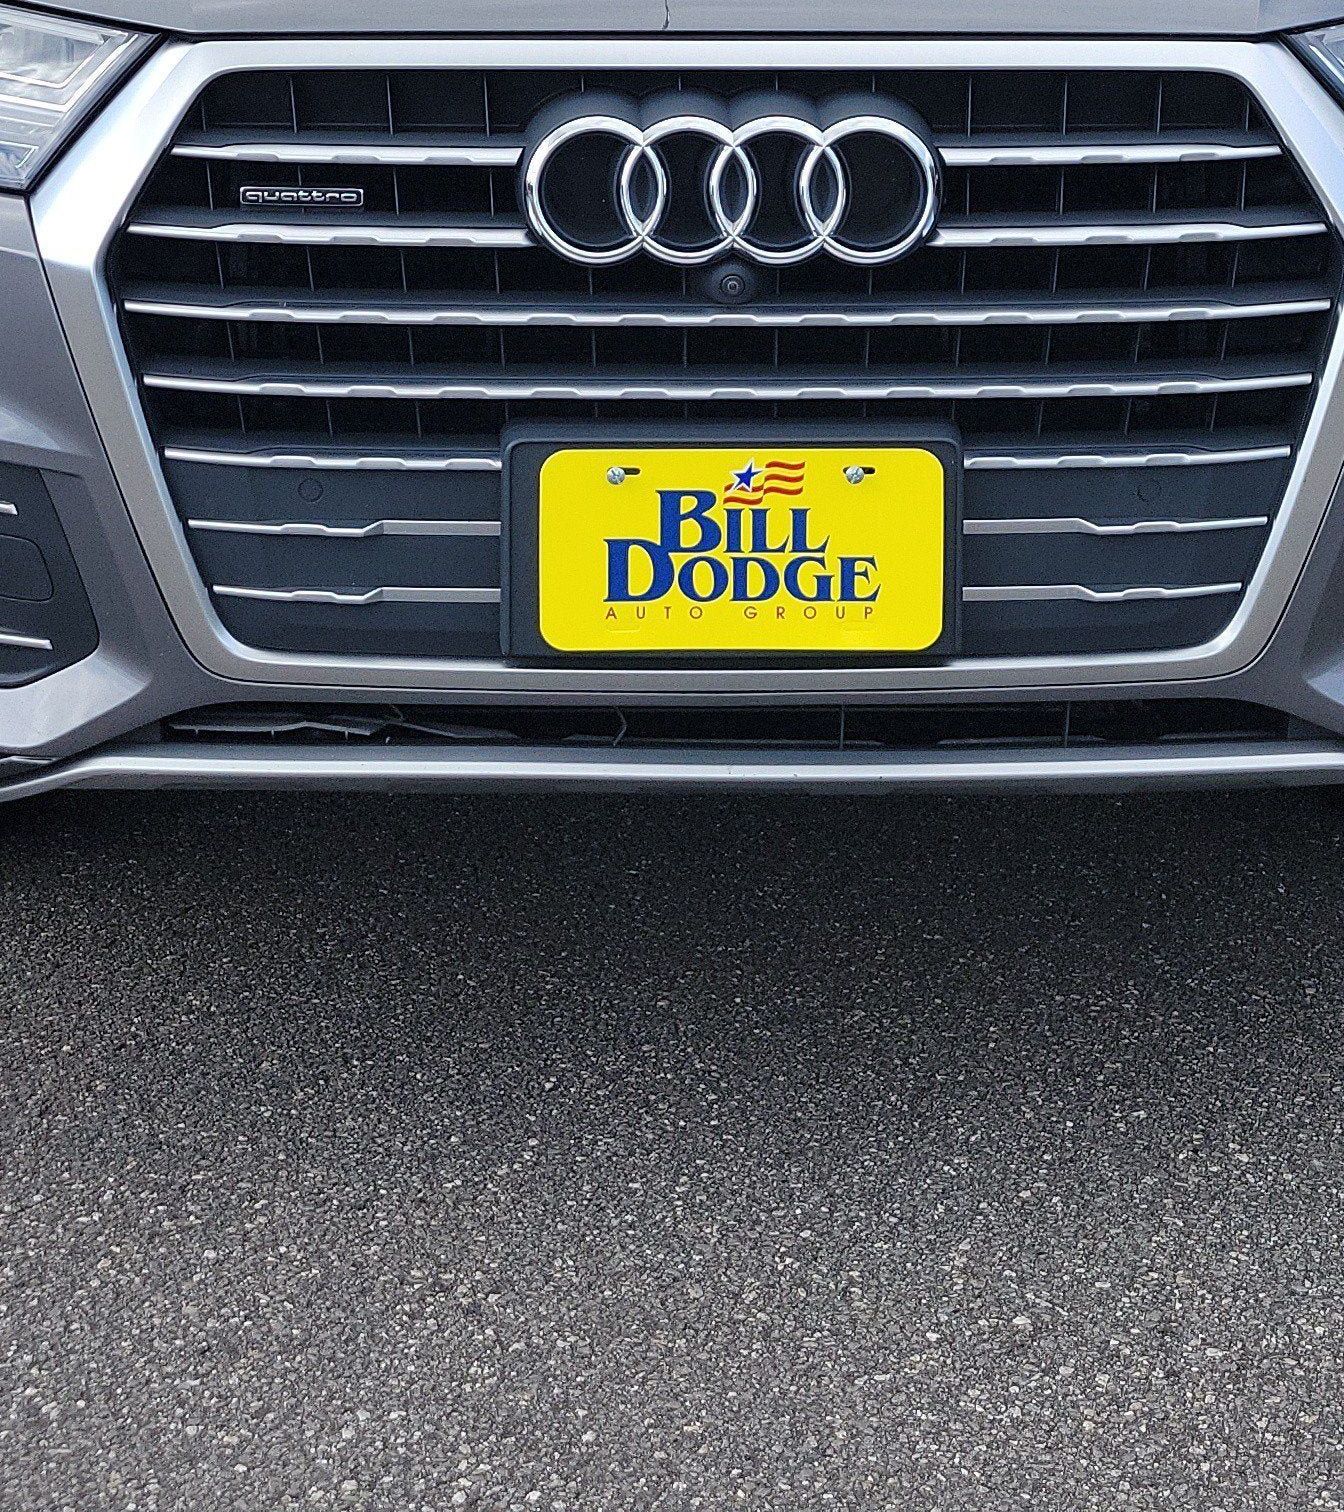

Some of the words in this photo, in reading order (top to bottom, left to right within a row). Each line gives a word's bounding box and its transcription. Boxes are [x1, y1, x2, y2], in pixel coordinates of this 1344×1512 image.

[245, 190, 358, 203] quattro
[655, 489, 831, 554] BILL
[602, 538, 882, 603] DODGE
[604, 605, 704, 620] AUTO
[743, 605, 875, 620] GROUP
